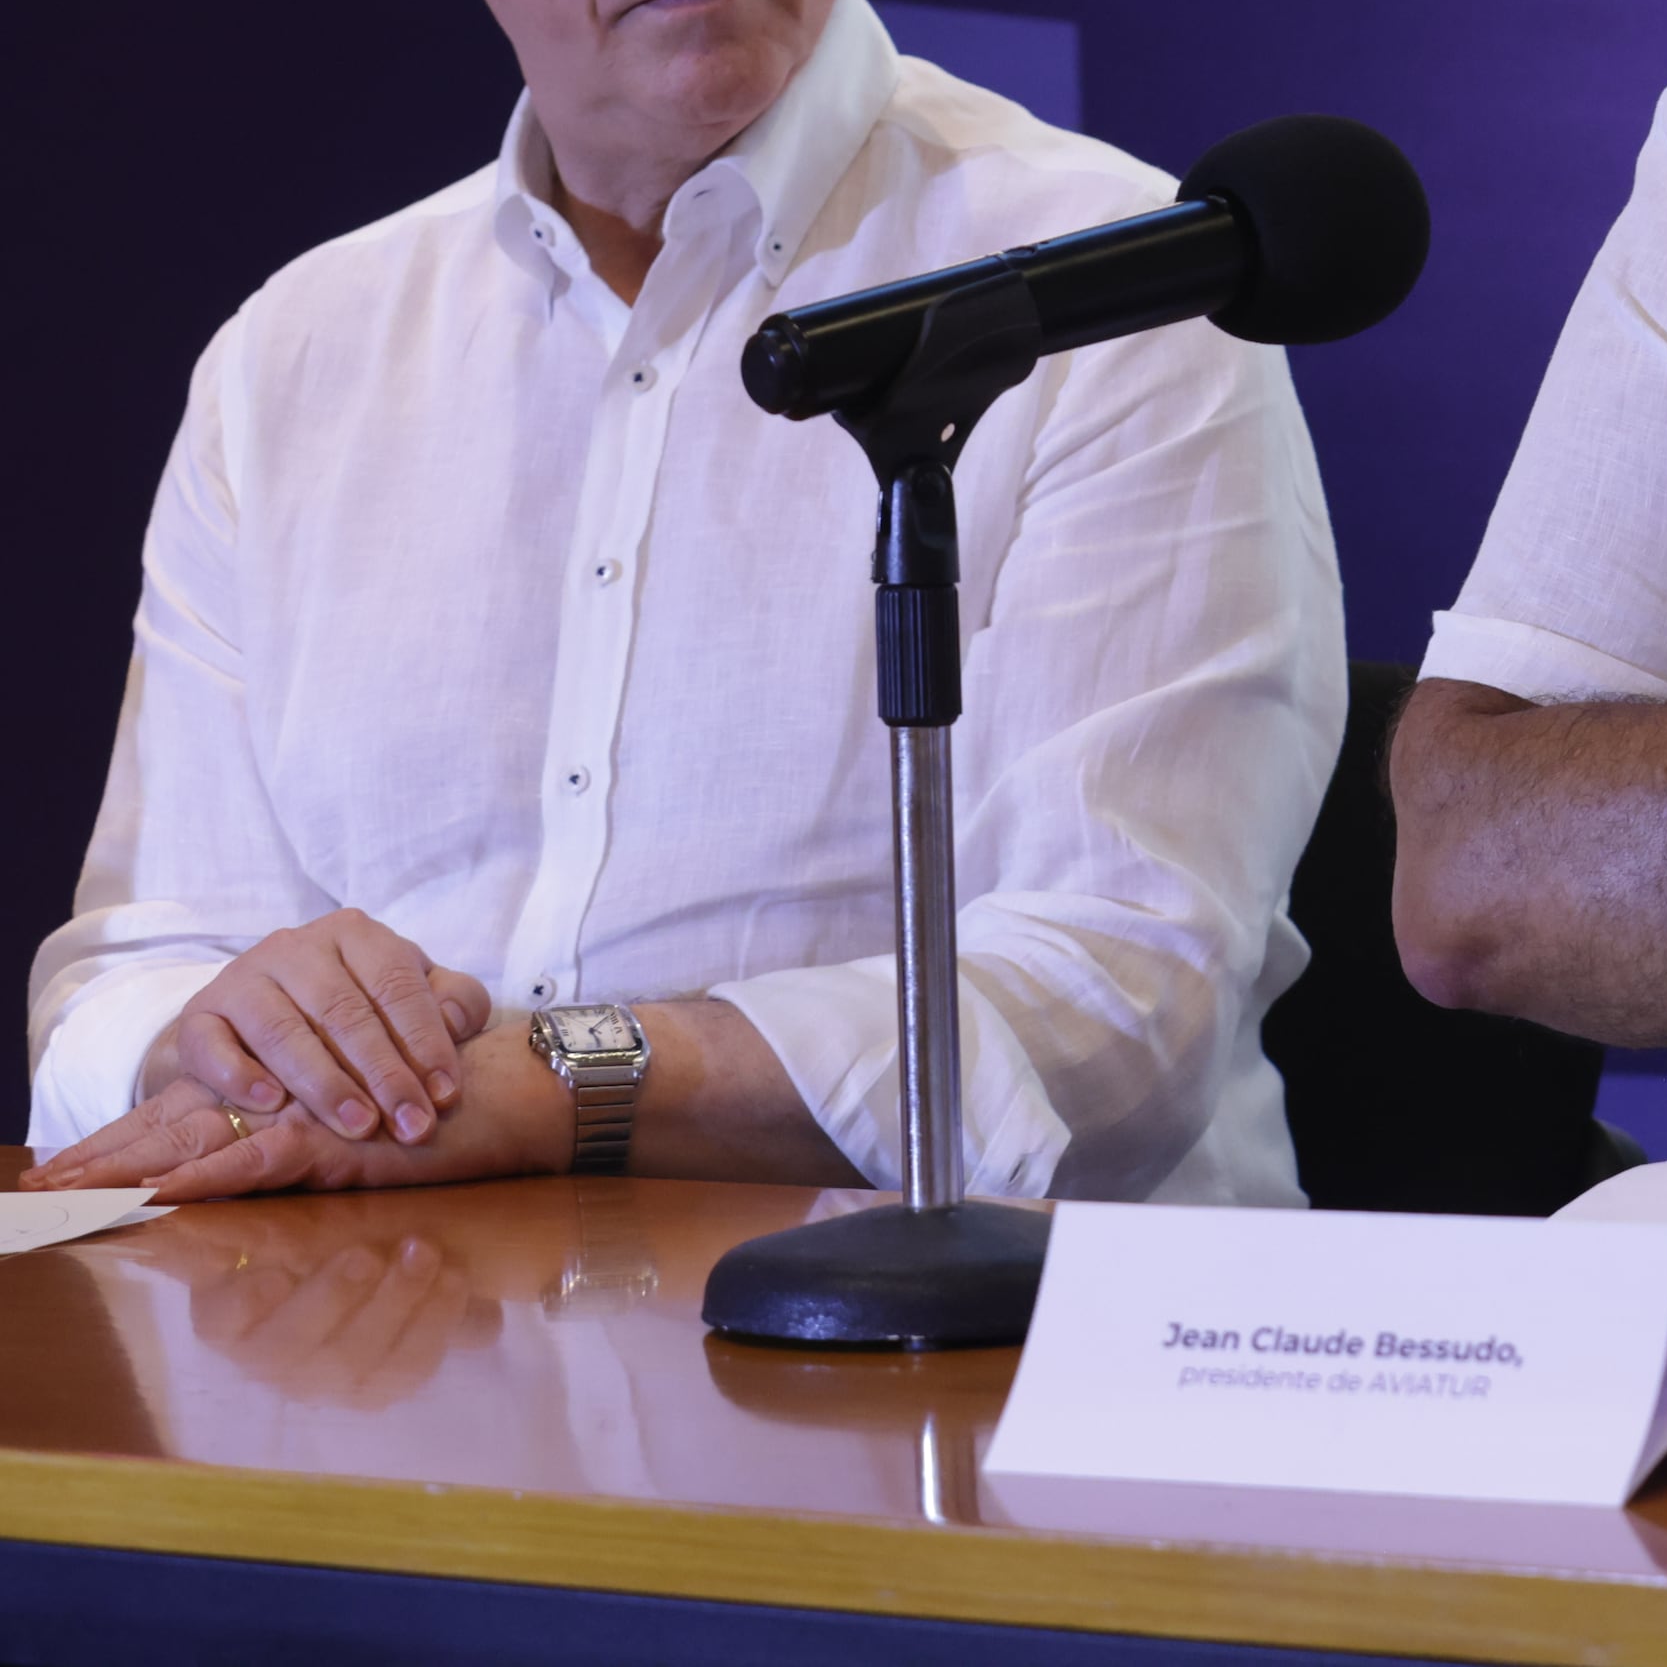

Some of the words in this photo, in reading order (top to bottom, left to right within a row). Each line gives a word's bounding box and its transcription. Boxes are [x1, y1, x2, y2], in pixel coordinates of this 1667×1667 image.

[1162, 1321, 1240, 1351] Jean
[1250, 1325, 1366, 1358] Claude
[1373, 1330, 1524, 1369] Bessudo,
[1176, 1363, 1322, 1392] presidente
[1327, 1368, 1364, 1394] de
[1368, 1370, 1493, 1400] AVIATUR
